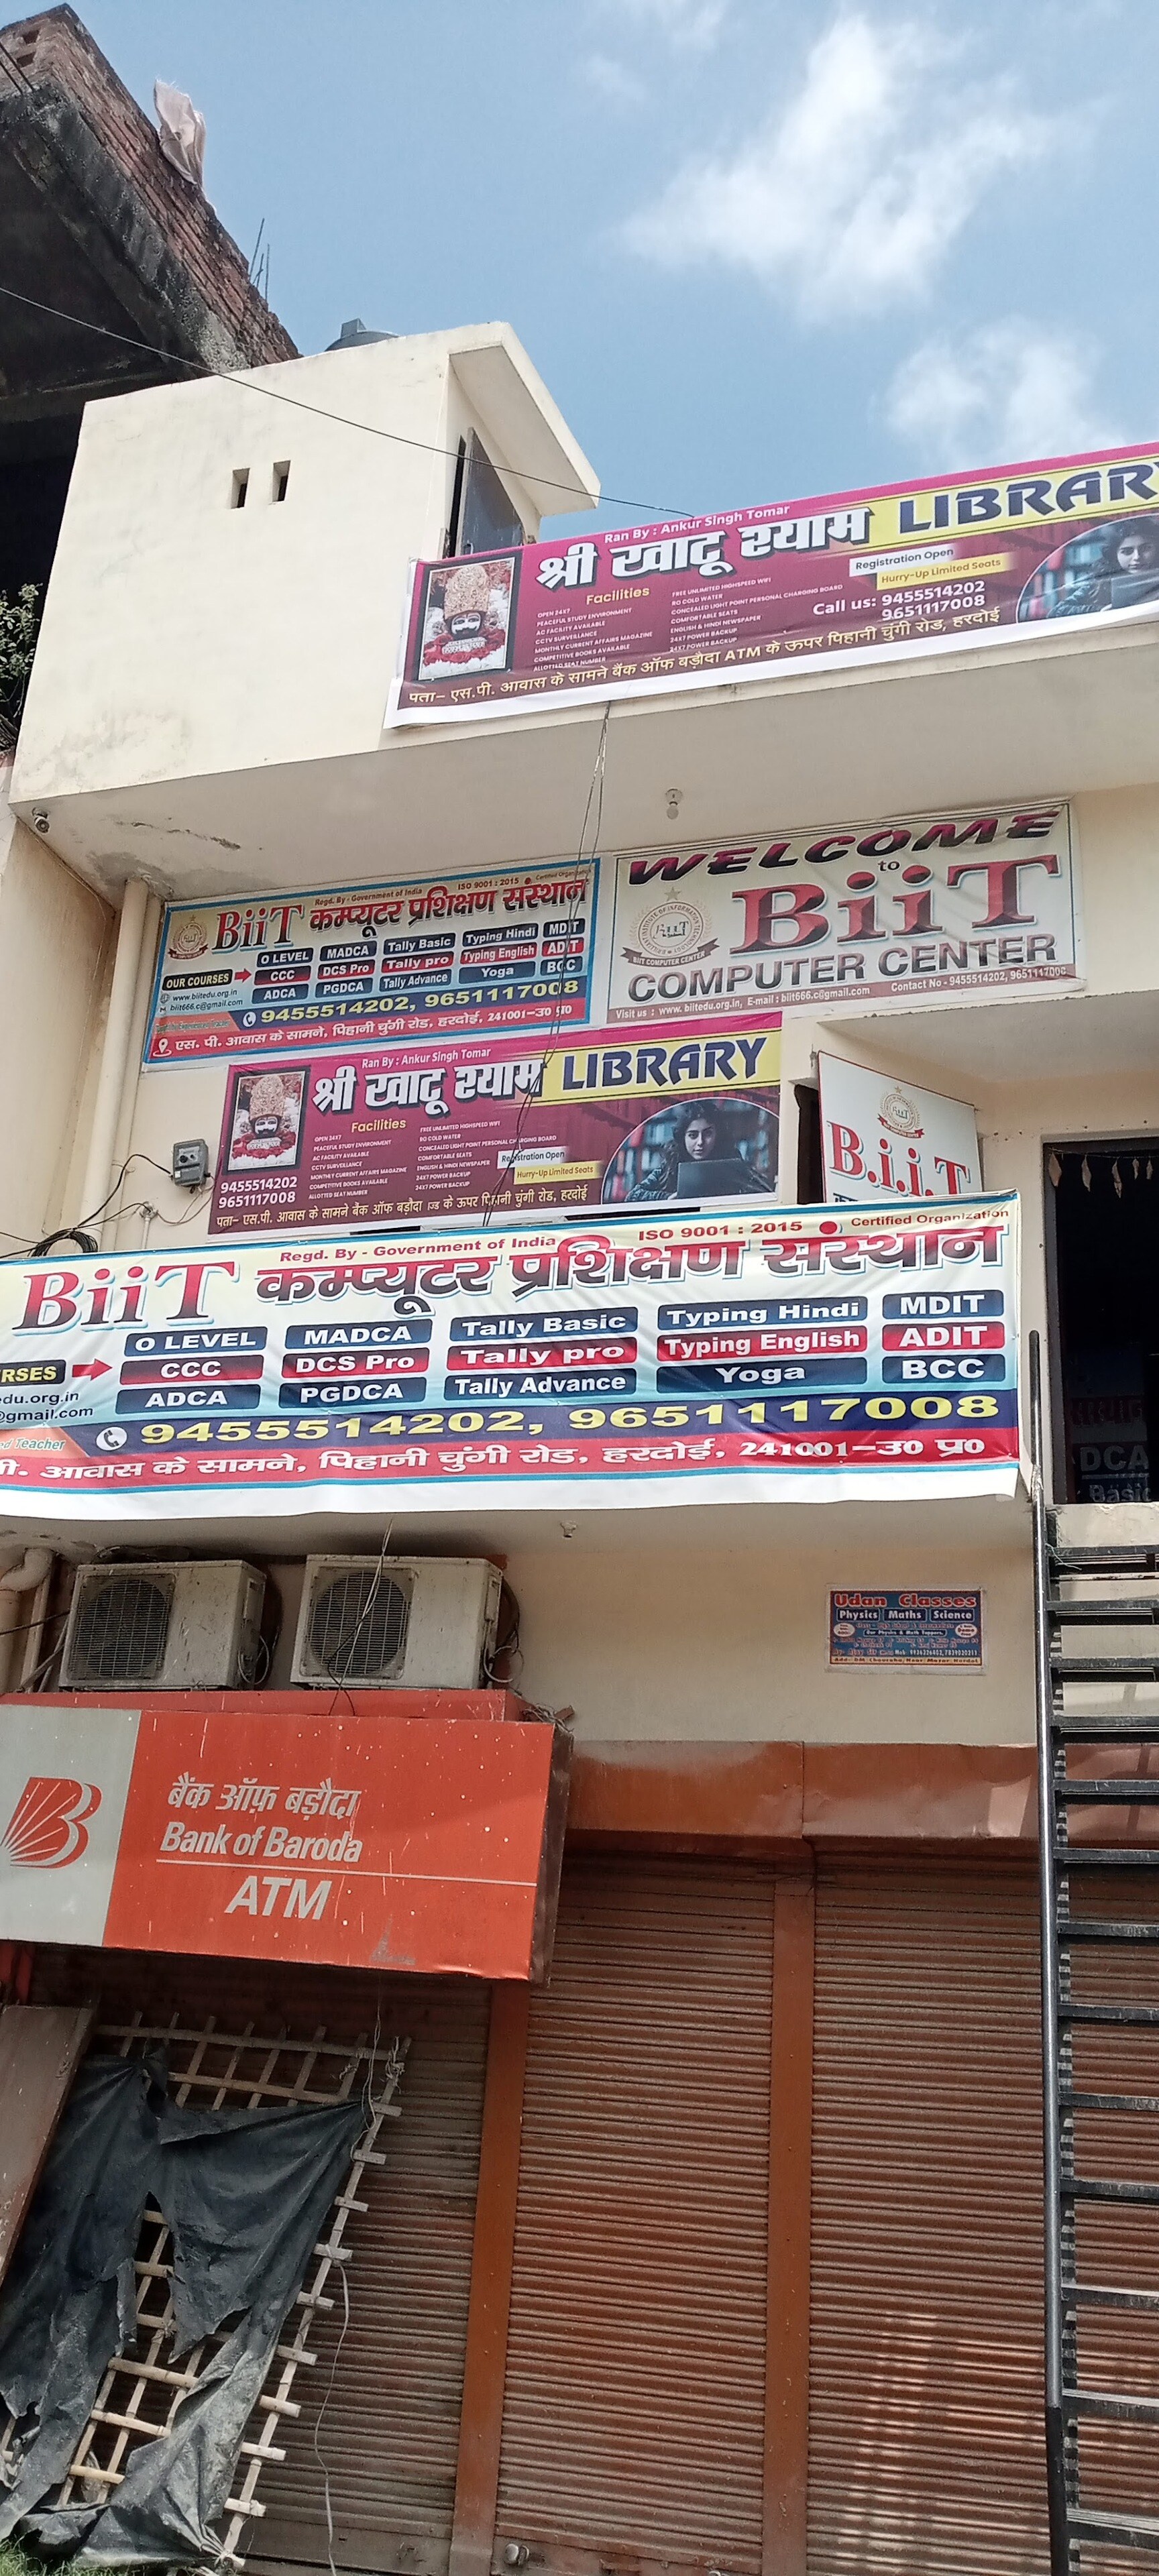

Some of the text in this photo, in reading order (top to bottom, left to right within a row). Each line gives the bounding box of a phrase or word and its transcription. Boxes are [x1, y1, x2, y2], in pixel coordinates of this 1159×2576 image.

[537, 462, 1159, 590] श्री खाटू श्याम LIBRAR
[605, 505, 790, 543] Ran By Ankur Singh Tomar
[856, 547, 953, 571] Registration Open
[881, 559, 1001, 584] Hurry-Up Limited Seats
[586, 587, 649, 605] Facilities
[701, 594, 722, 602] WATER
[813, 581, 985, 616] Call us: 9455514202
[883, 595, 985, 621] 9651117008
[500, 677, 546, 693] आवास
[550, 672, 564, 687] के
[568, 668, 608, 684] सामने
[612, 662, 636, 678] बैंक
[724, 647, 761, 661] ATM
[765, 640, 781, 655] के
[784, 636, 823, 651] ऊपर
[828, 626, 876, 647] पिहानी
[952, 608, 1001, 628] हरदोई
[629, 811, 1060, 885] WELCOME
[878, 860, 900, 871] to
[730, 854, 1060, 955] BiiT
[212, 905, 302, 952] BiiT
[261, 928, 535, 964] O LEVEL MADCA Tally Basic Typing Hindi
[166, 946, 534, 988] OUR COURSES CCC DCS Pro Tally pro Typing English
[264, 967, 514, 1000] ADCA PGDCA Yoga
[628, 934, 1057, 1003] COMPUTER CENTER
[616, 1009, 634, 1018] Visit
[748, 997, 774, 1005] E-mail
[891, 982, 926, 992] Contact
[312, 1066, 357, 1112] श्री
[365, 1068, 449, 1116] खाटू
[563, 1037, 767, 1091] LIBRARY
[351, 1119, 406, 1133] Facilities
[221, 1177, 297, 1193] 9455514202
[517, 1165, 594, 1179] Hurry-Up Limited Seats
[219, 1191, 296, 1209] 9651117008
[280, 1209, 1009, 1262] Regd. By Government of India ISO 9001 2015 Certified Organization
[12, 1261, 235, 1331] BiiT
[135, 1294, 985, 1351] O LEVEL MADCA Tally Basic Typing Hindi MDIT
[0, 1326, 988, 1382] RSES CCC DCS Pro Tally pro Typing English ADIT
[145, 1359, 985, 1407] ADCA PGDCA Tally Advance Yoga BCC
[569, 1395, 999, 1429] 9651117008
[40, 1460, 144, 1479] आवास
[152, 1457, 189, 1474] के
[318, 1449, 430, 1469] पिहानी
[835, 1593, 976, 1607] Udan Classes
[840, 1610, 972, 1620] Physics Maths Science
[168, 1771, 214, 1809] बैंक
[160, 1822, 362, 1862] Bank of Baroda
[225, 1875, 331, 1920] ATM
